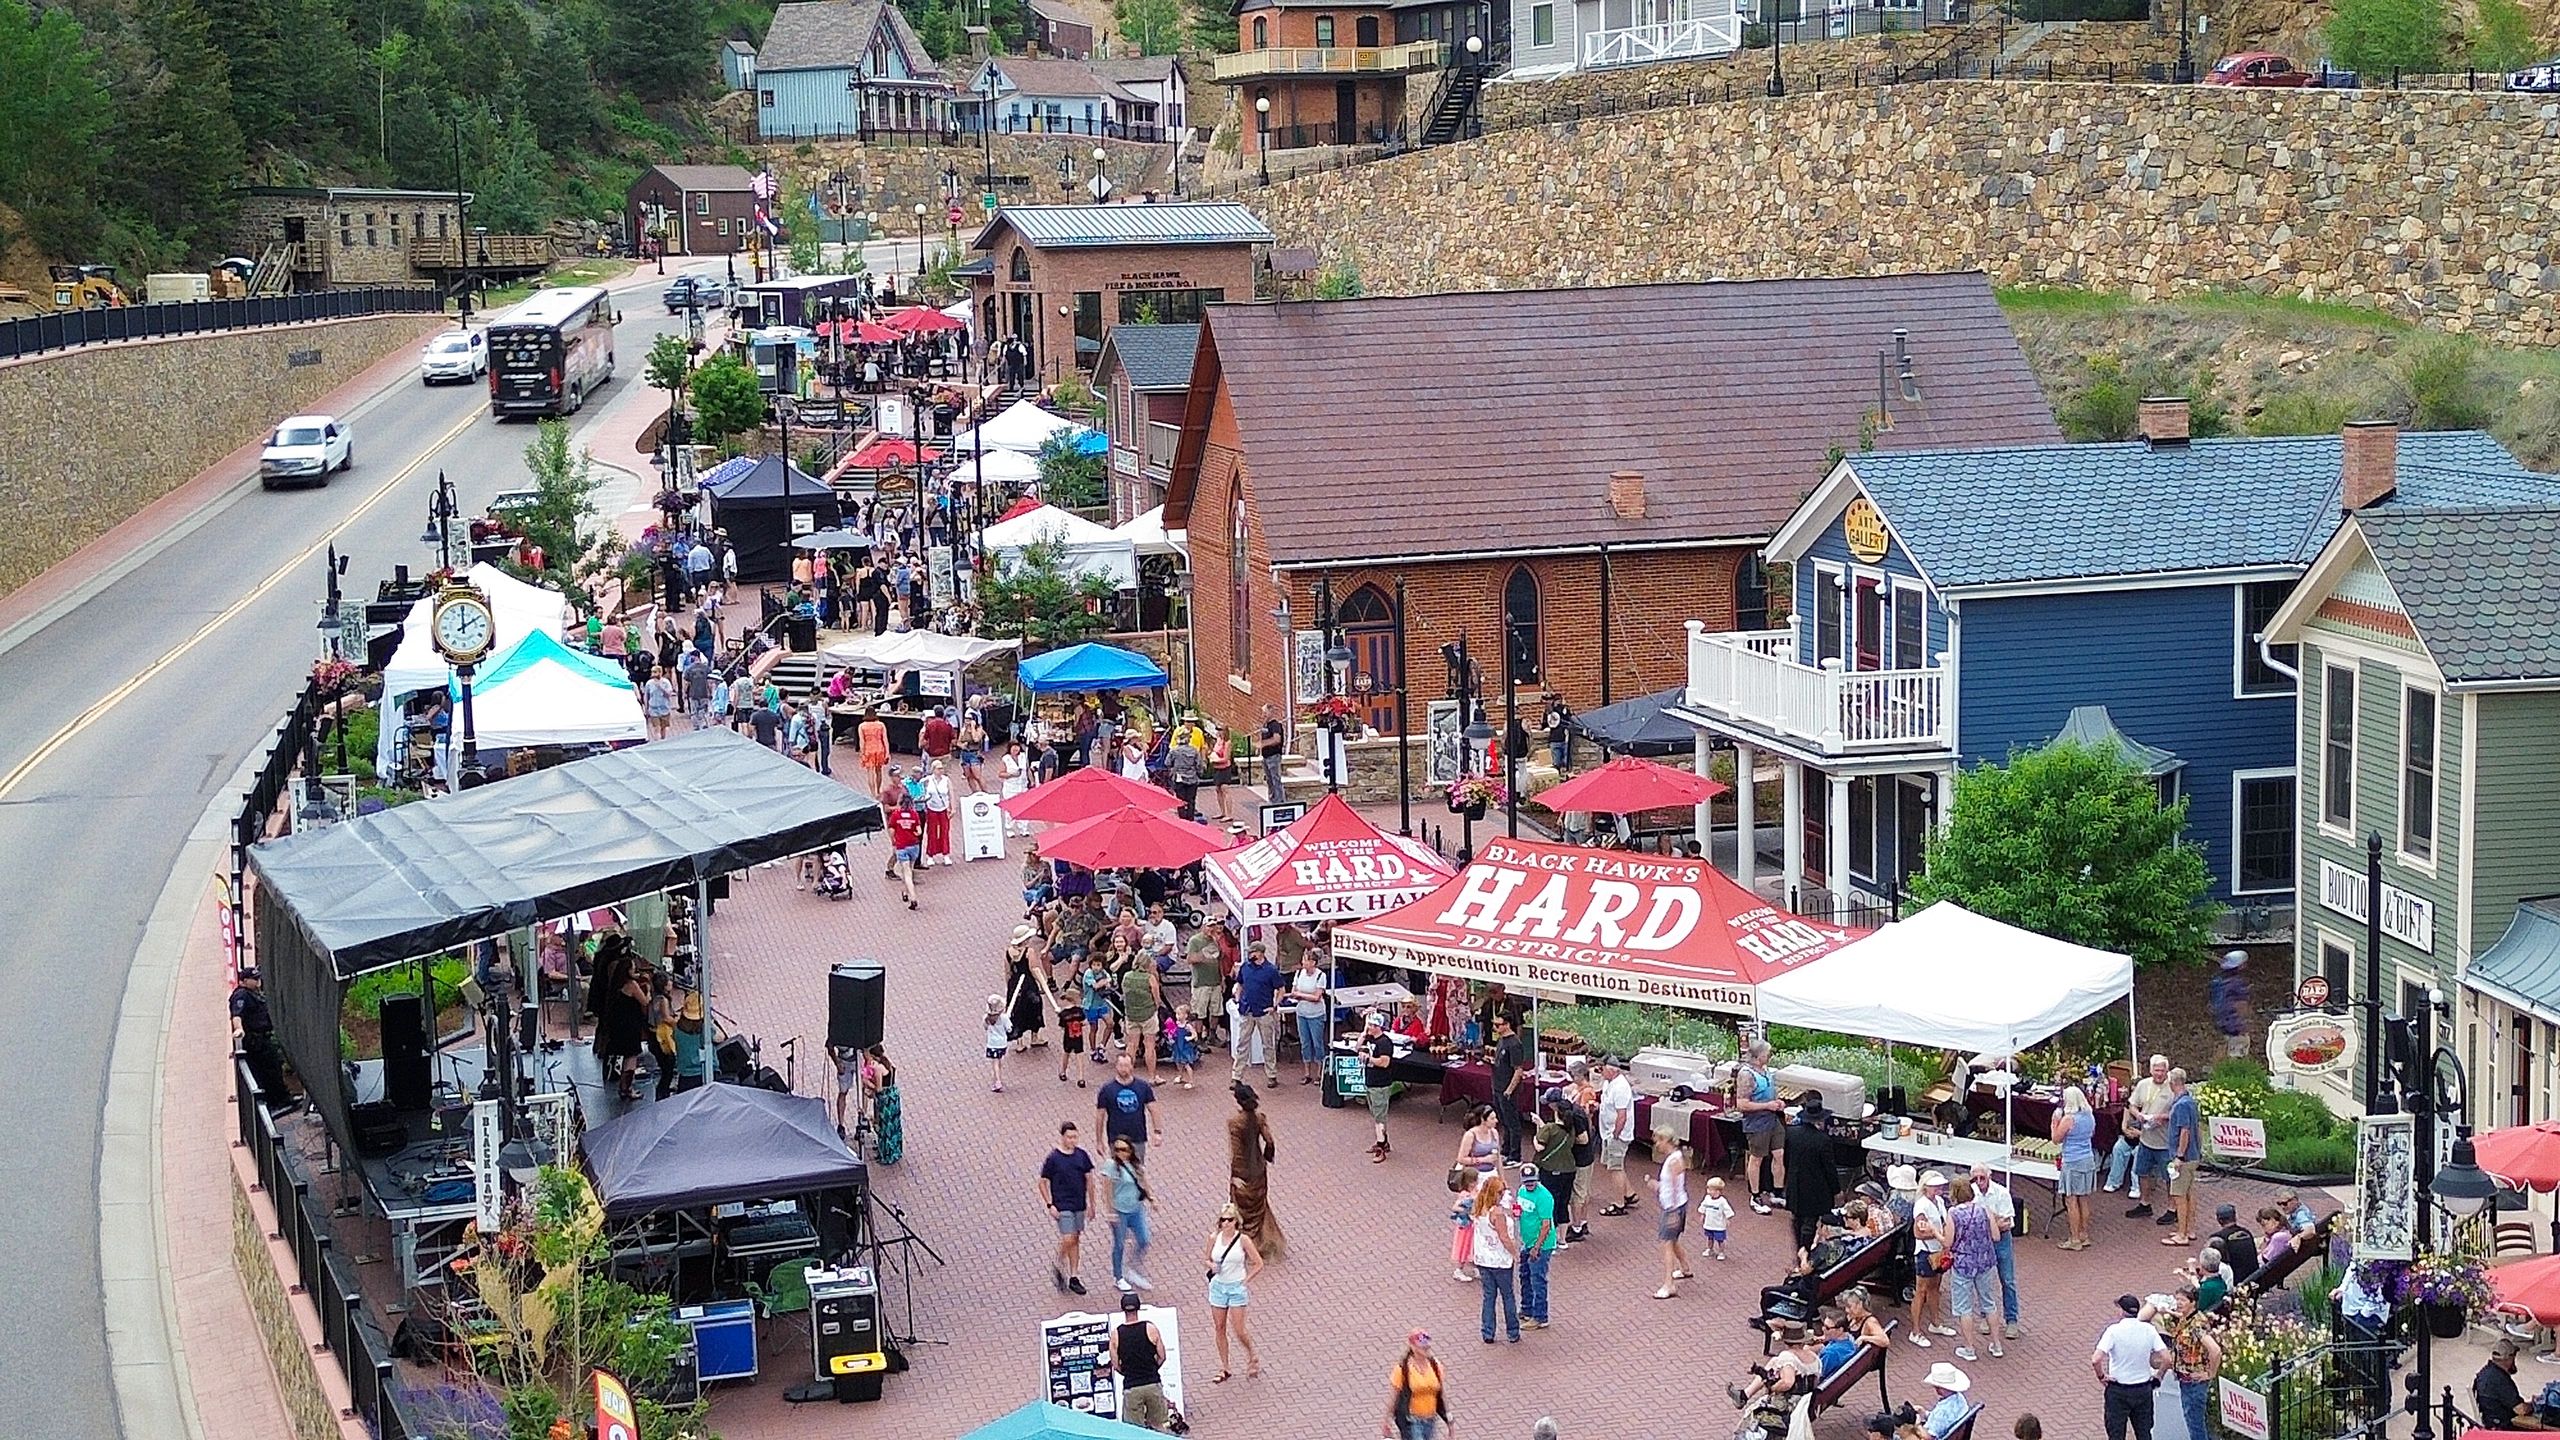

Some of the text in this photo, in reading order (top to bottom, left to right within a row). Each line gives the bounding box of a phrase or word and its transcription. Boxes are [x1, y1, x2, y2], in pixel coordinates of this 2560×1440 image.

[1120, 271, 1181, 280] BLACK HAWK
[1857, 515, 1874, 529] ART
[1848, 528, 1885, 551] GALLERY
[1303, 838, 1383, 853] WELCOME
[1316, 847, 1375, 858] TO THE
[1290, 853, 1405, 886] HARD
[1486, 845, 1701, 884] BLACK HAWK'S
[1257, 895, 1354, 919] BLACK
[1435, 863, 1702, 951] HARD
[1727, 906, 1778, 928] WELCOME
[2384, 889, 2393, 929] &
[1742, 921, 1761, 933] TO
[1736, 919, 1827, 965] HARD
[1333, 934, 1752, 1006] History Appreciation Recreation Destination
[482, 1116, 491, 1169] BLACK
